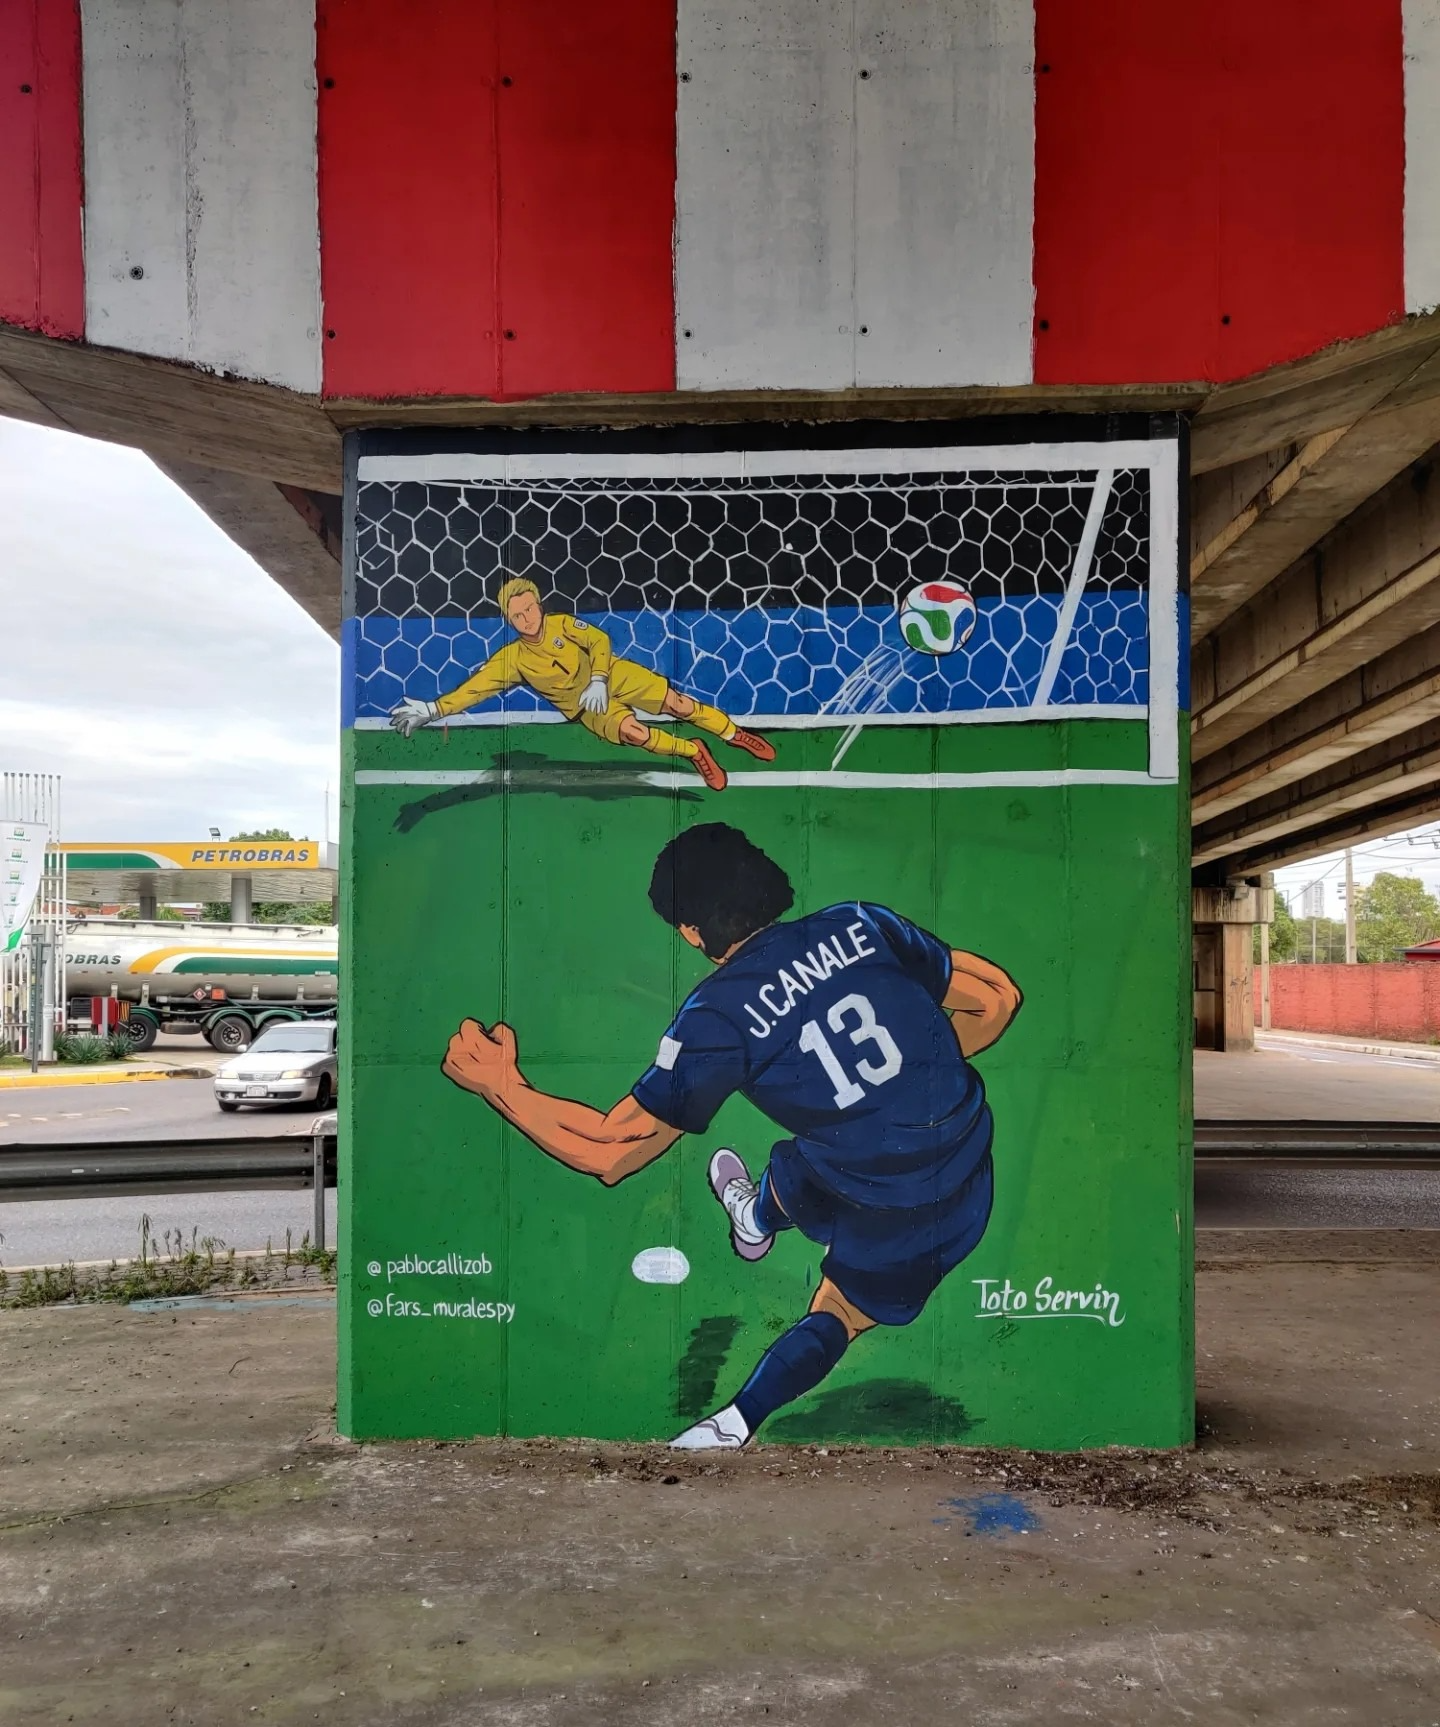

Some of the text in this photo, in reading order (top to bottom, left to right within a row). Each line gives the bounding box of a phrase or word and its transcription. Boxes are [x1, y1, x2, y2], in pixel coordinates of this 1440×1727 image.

[191, 849, 309, 862] PETROBRAS
[744, 922, 876, 1039] J.CANALE
[798, 993, 903, 1110] 13
[971, 1276, 1127, 1328] Toto Servin
